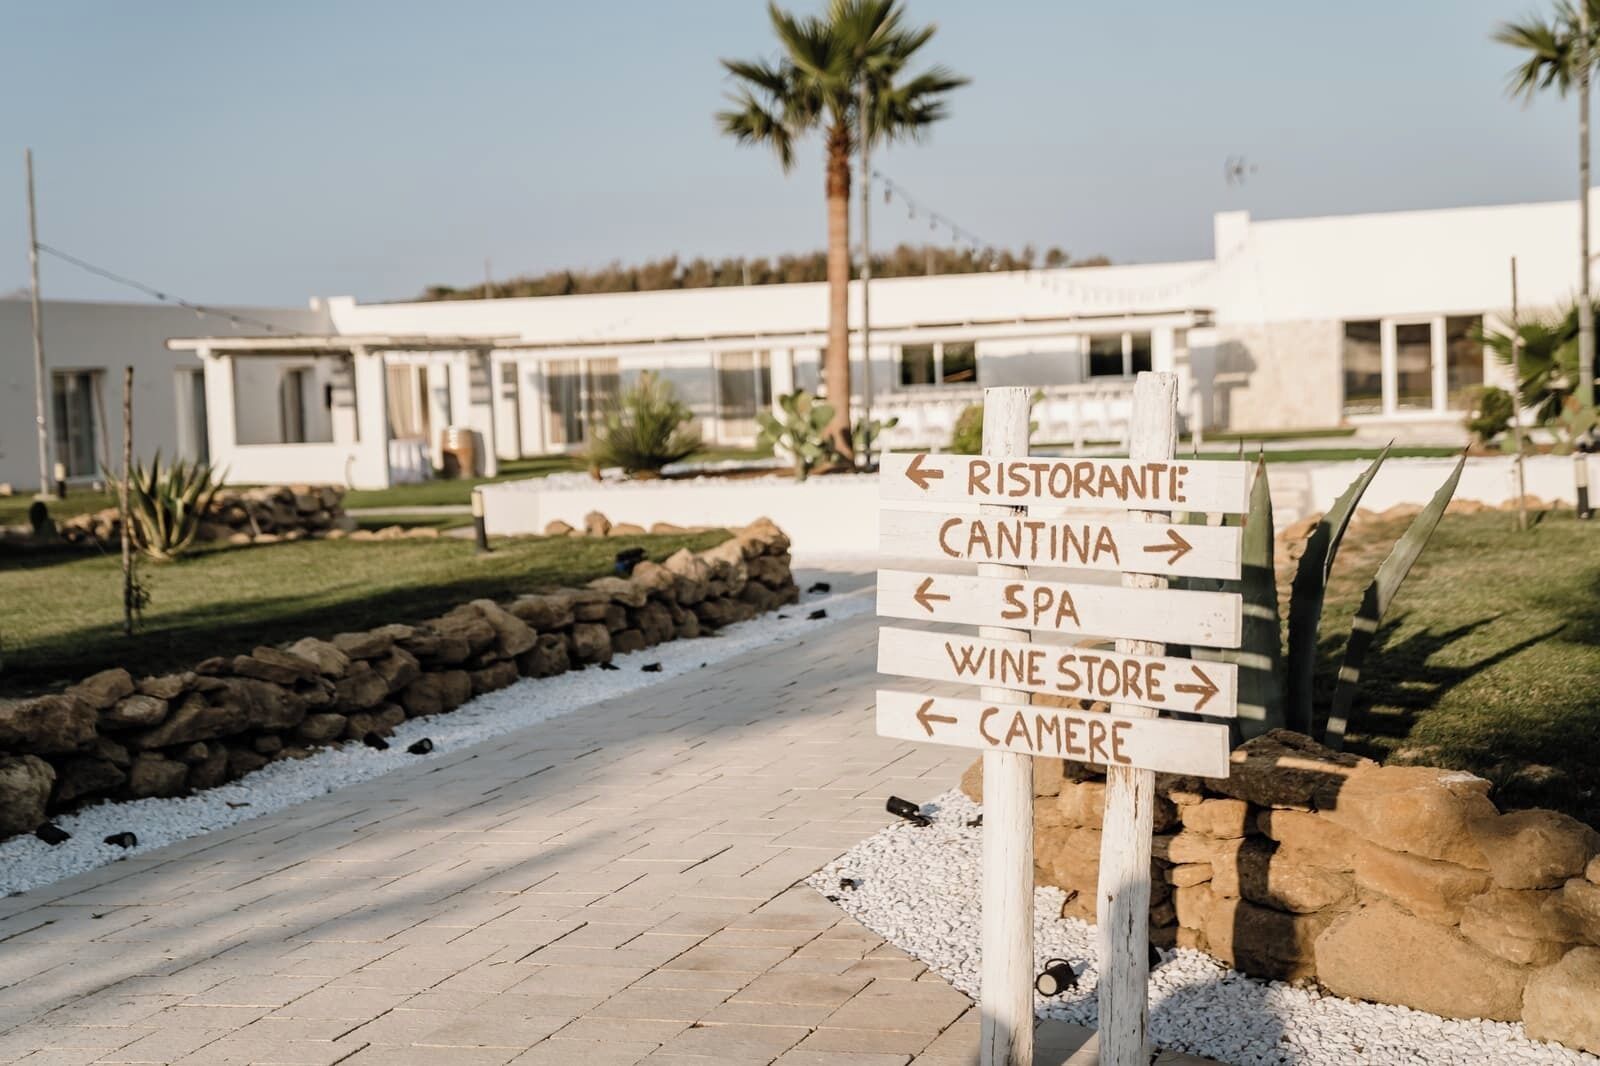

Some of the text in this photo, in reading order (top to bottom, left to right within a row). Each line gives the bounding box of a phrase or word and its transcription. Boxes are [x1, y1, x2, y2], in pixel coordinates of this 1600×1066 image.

[968, 460, 1188, 503] RISTORANTE
[939, 518, 1120, 565] CANTINA
[1000, 584, 1080, 629] SPA
[945, 641, 1166, 702] WINE STORE
[979, 707, 1133, 765] CAMERE
